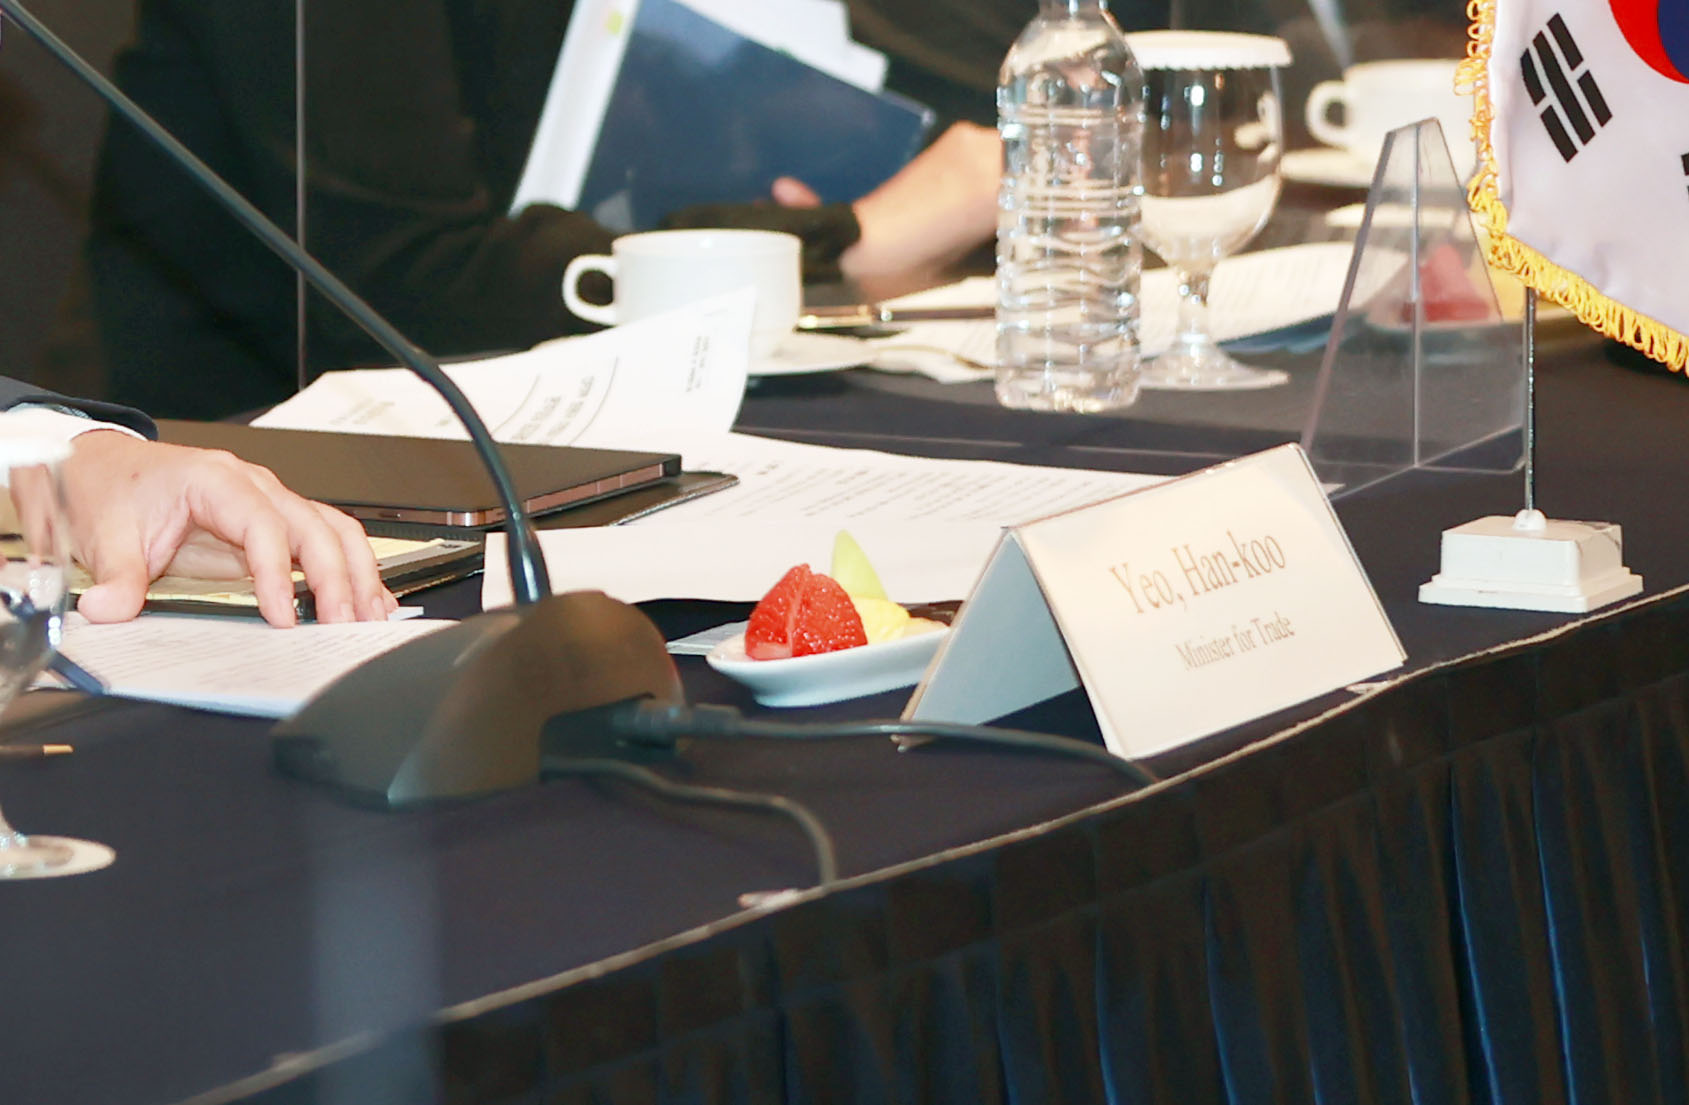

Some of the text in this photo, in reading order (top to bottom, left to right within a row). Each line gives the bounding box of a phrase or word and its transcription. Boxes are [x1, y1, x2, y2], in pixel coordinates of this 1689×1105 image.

[1109, 530, 1286, 614] Yeo, Han-koo
[1175, 610, 1296, 671] Minister for Trade
